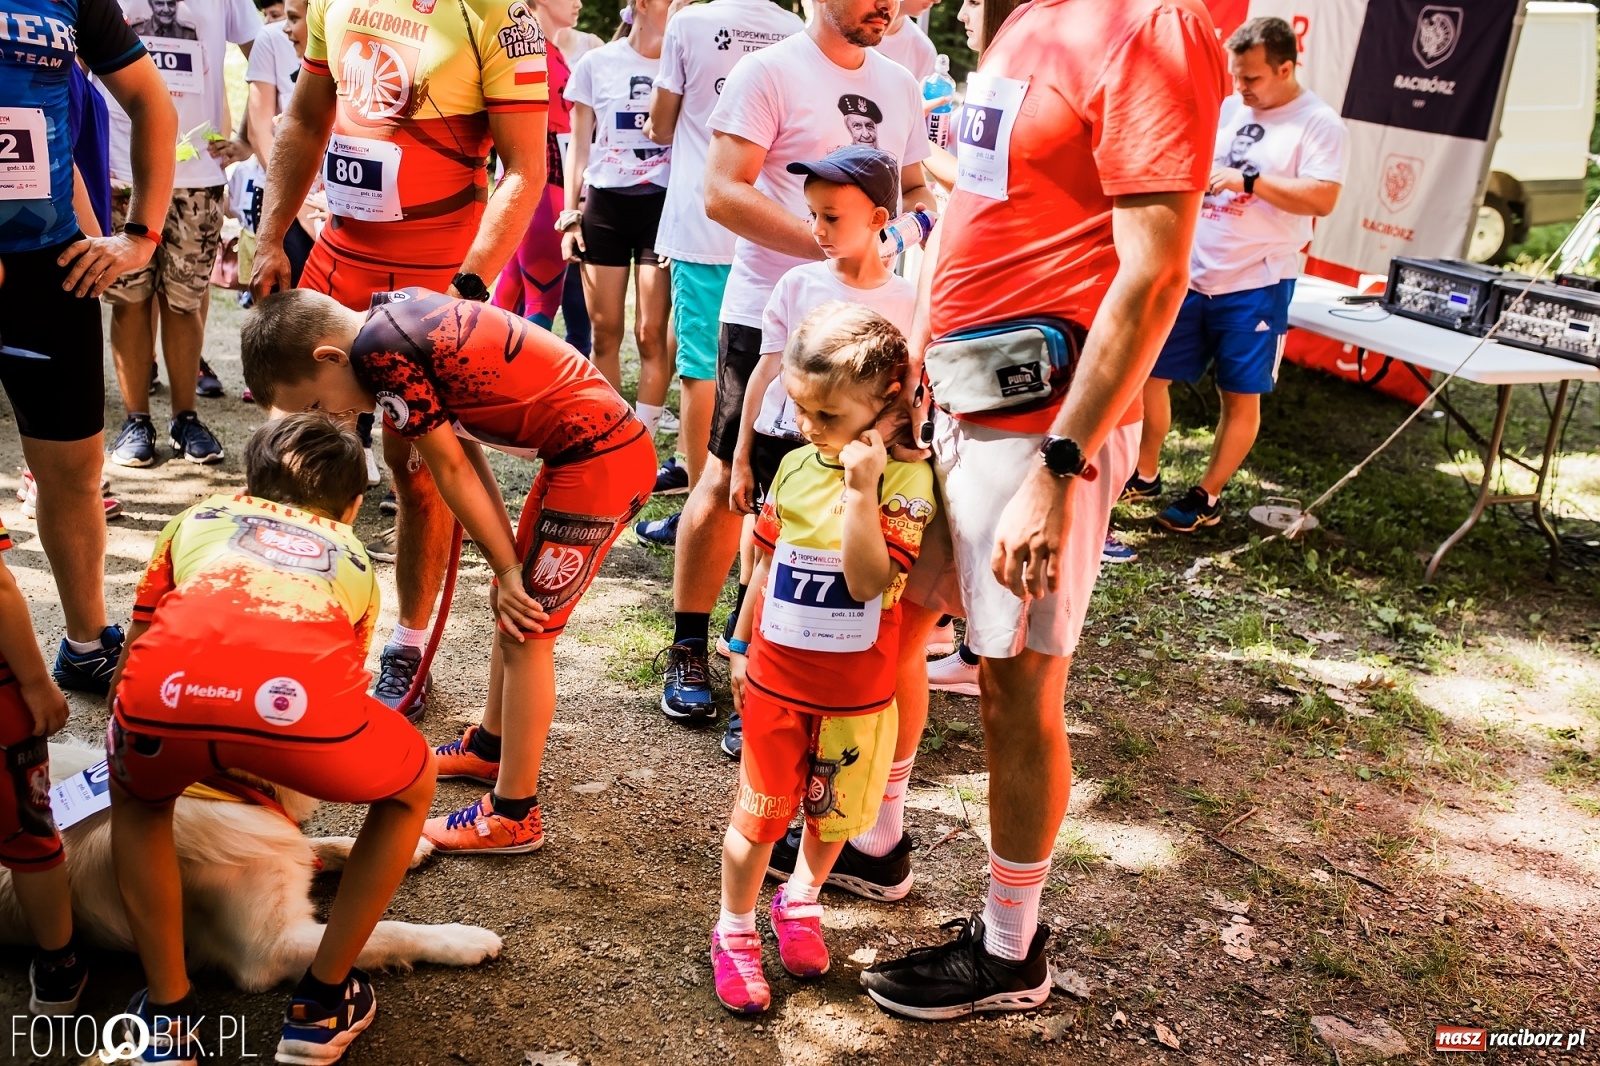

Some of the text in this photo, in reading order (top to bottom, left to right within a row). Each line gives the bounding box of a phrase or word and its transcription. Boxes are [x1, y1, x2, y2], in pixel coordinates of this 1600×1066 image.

[347, 7, 430, 43] RACIBORKI
[14, 50, 63, 69] TEAM
[152, 52, 178, 69] 10
[963, 107, 987, 142] 76
[335, 158, 363, 184] 80
[1007, 373, 1032, 385] PUMA
[541, 520, 608, 541] RACIBORKI
[888, 519, 924, 533] POLSK
[791, 570, 836, 603] 77
[185, 683, 243, 702] MebRaj
